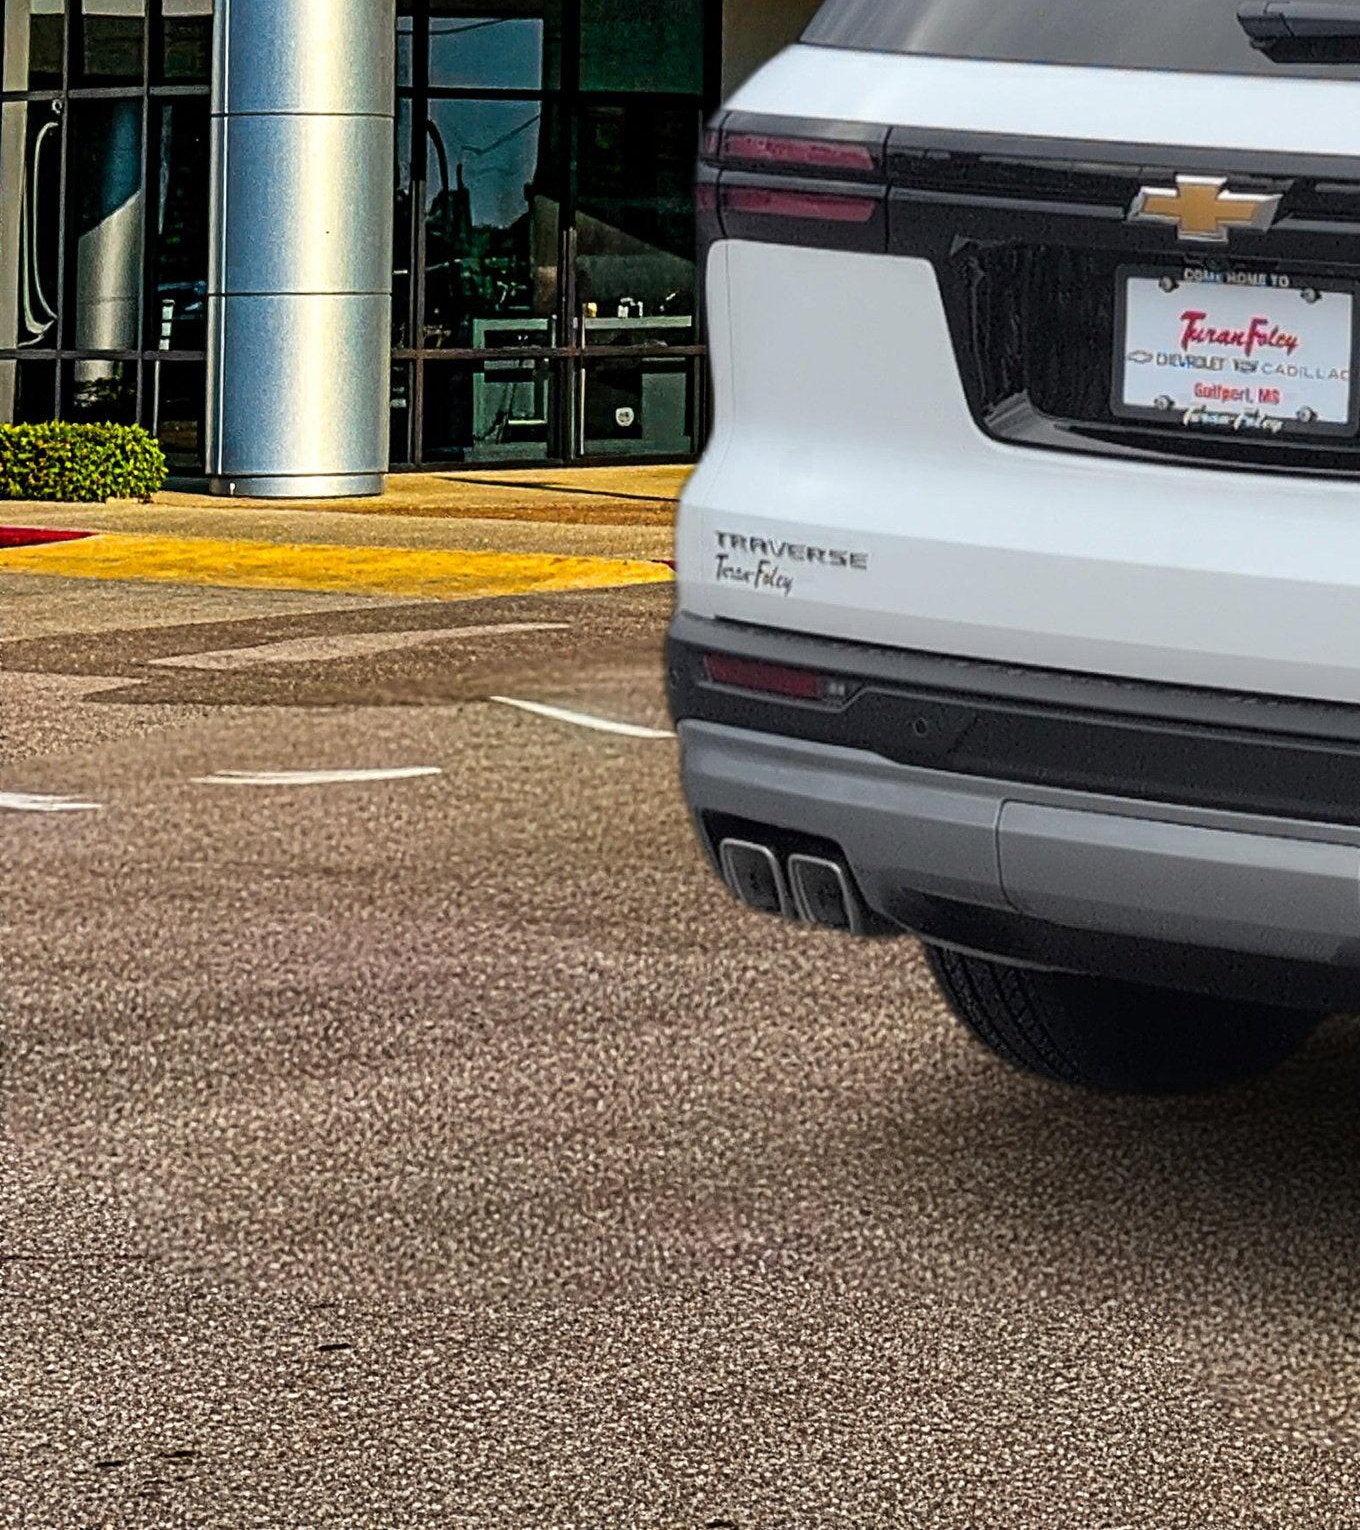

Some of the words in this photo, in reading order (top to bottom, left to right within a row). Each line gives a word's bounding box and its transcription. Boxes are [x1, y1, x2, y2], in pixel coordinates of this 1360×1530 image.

[1270, 274, 1290, 288] TO
[1242, 318, 1301, 356] Foley
[1261, 363, 1350, 381] CADILLAC
[1258, 387, 1281, 405] MS
[715, 530, 869, 571] TRAVERSE
